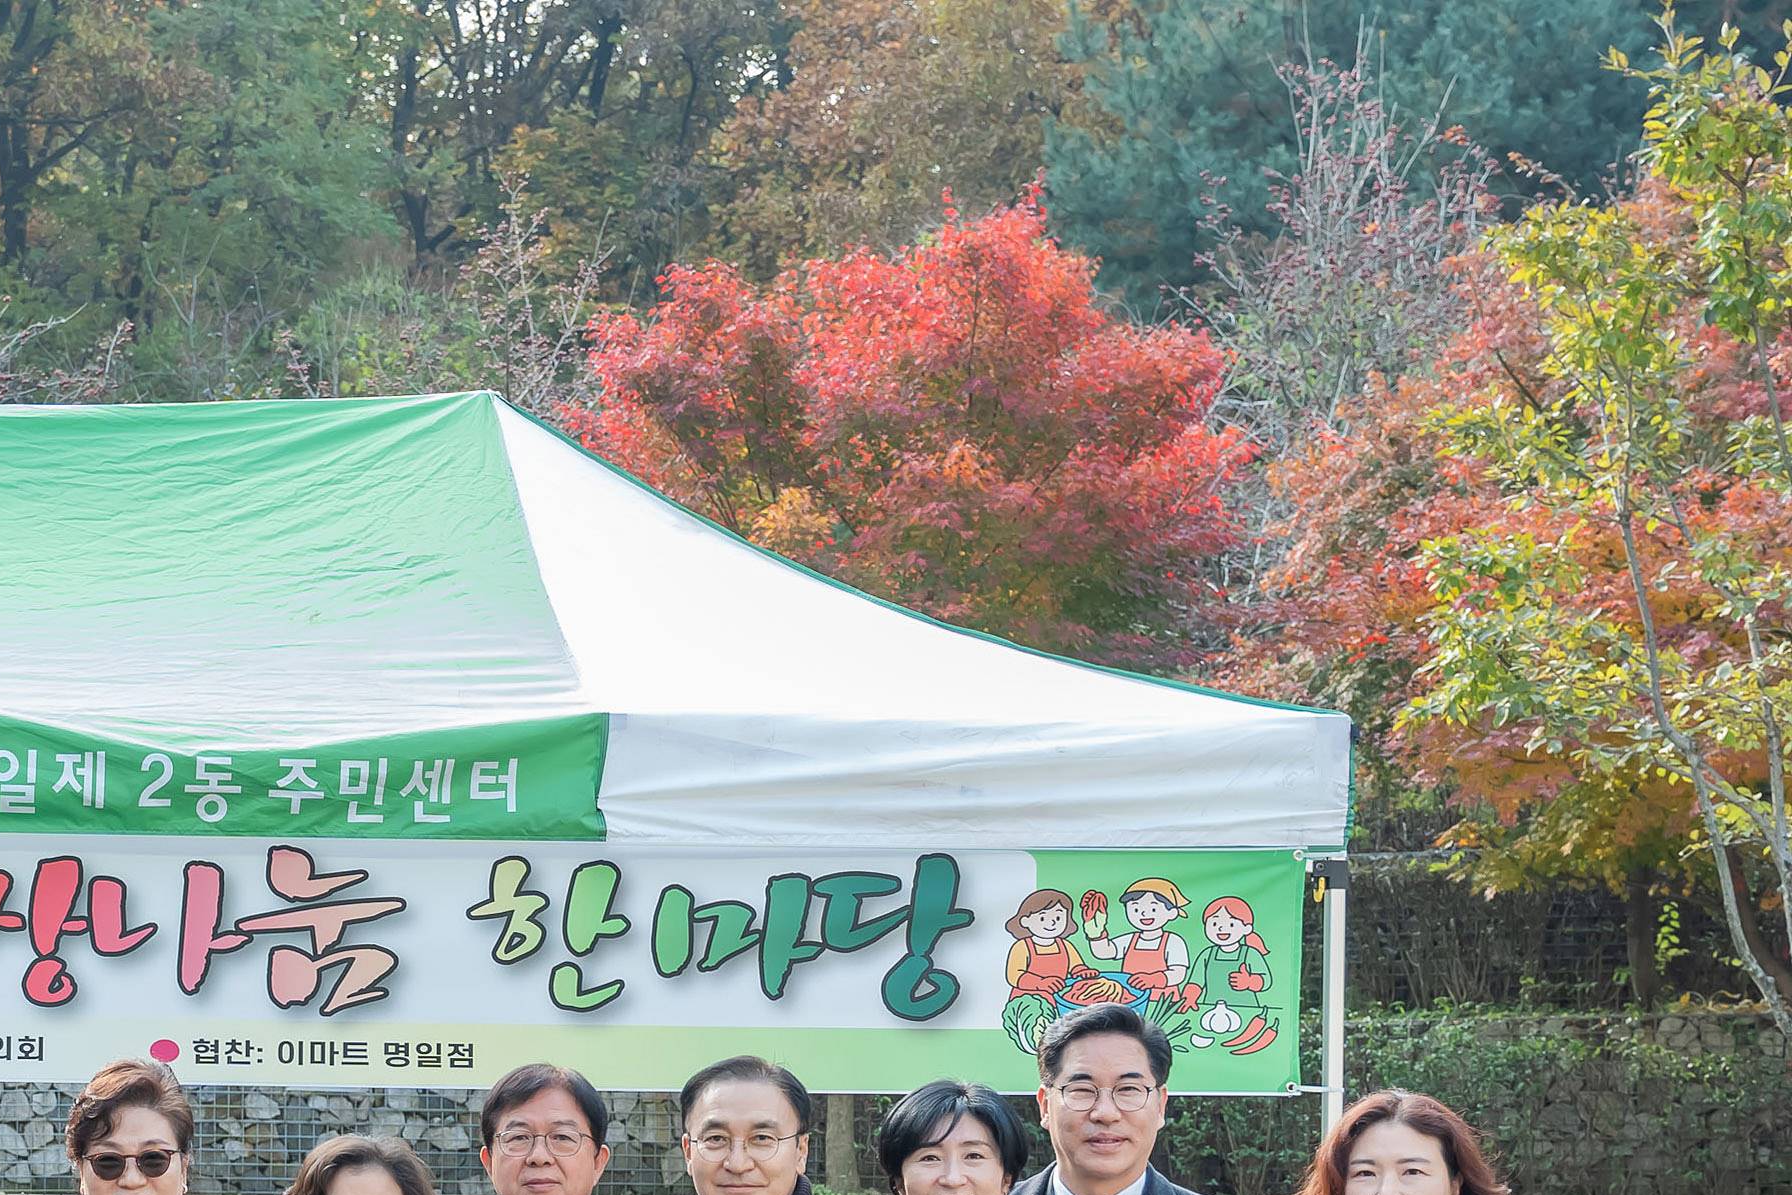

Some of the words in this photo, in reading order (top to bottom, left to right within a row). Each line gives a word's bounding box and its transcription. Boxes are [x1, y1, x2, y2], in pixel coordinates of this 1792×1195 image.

[139, 751, 234, 823] 2동
[267, 755, 520, 824] 주민센터
[467, 853, 973, 1021] 한마당
[192, 1038, 264, 1065] 협찬:
[277, 1040, 369, 1066] 이마트
[384, 1042, 474, 1069] 명일점
